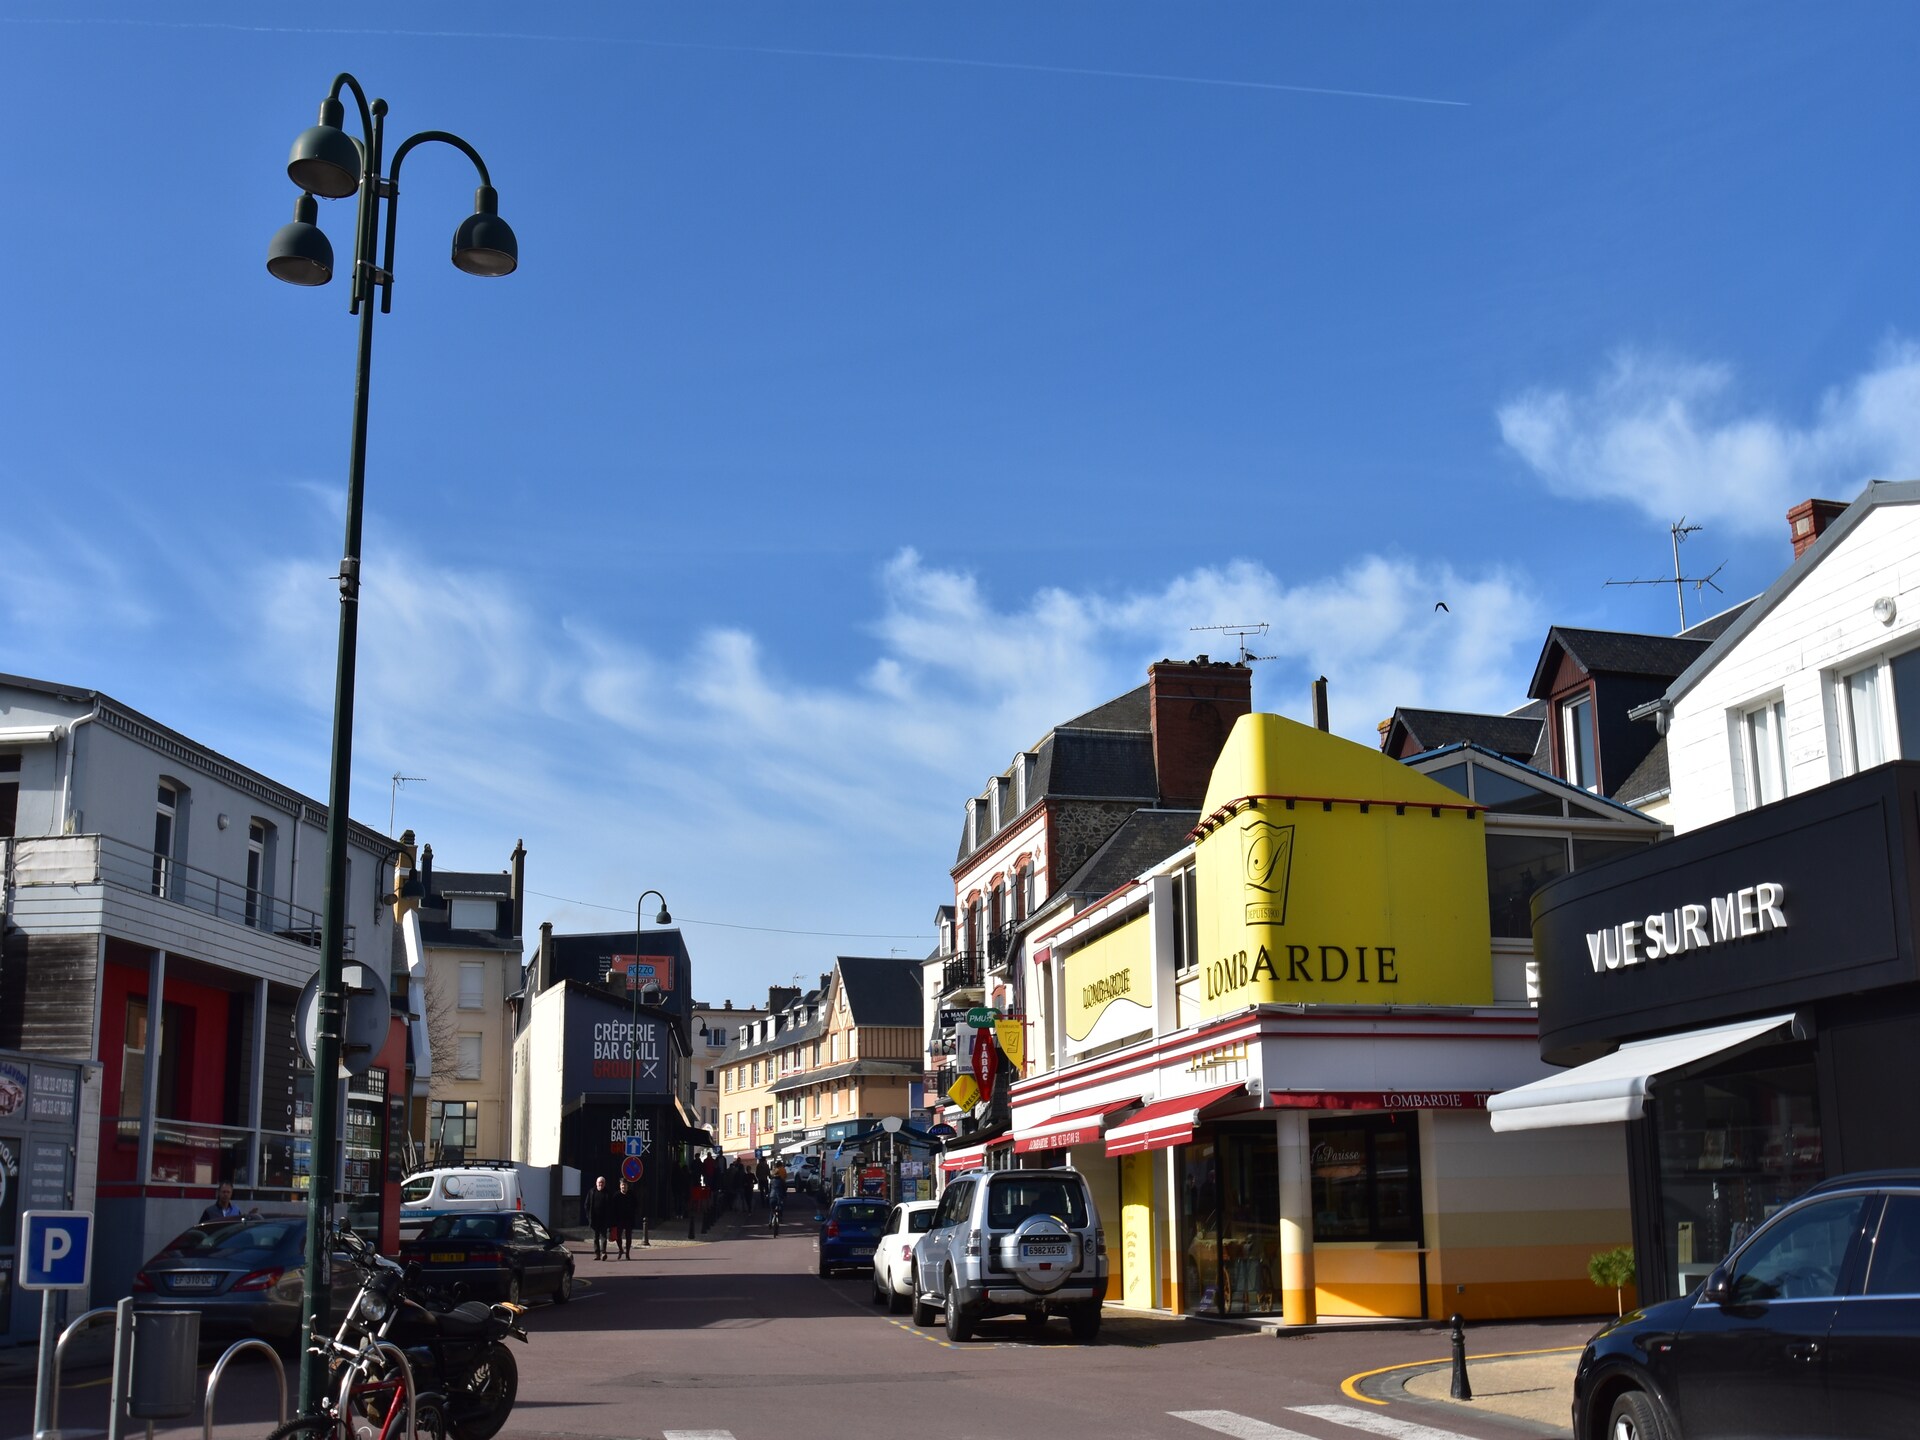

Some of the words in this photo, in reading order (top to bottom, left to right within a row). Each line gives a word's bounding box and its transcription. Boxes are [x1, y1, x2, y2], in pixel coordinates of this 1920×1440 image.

[1586, 920, 1645, 973] VUE
[1645, 904, 1710, 960] SUR
[1711, 882, 1787, 943] MER
[628, 965, 654, 975] POZZO
[1206, 944, 1398, 1001] LOMBARDIE
[1082, 967, 1131, 1010] LOMBARDIE
[594, 1019, 656, 1042] CRÊPERIE
[969, 1015, 987, 1023] PMU
[594, 1041, 620, 1060] BAR
[981, 1043, 989, 1081] TABAC
[1382, 1094, 1462, 1107] LOMBARDIE
[0, 1139, 18, 1177] IQUE
[42, 1227, 72, 1273] P
[1028, 1246, 1047, 1255] 6982
[1056, 1246, 1065, 1254] 50
